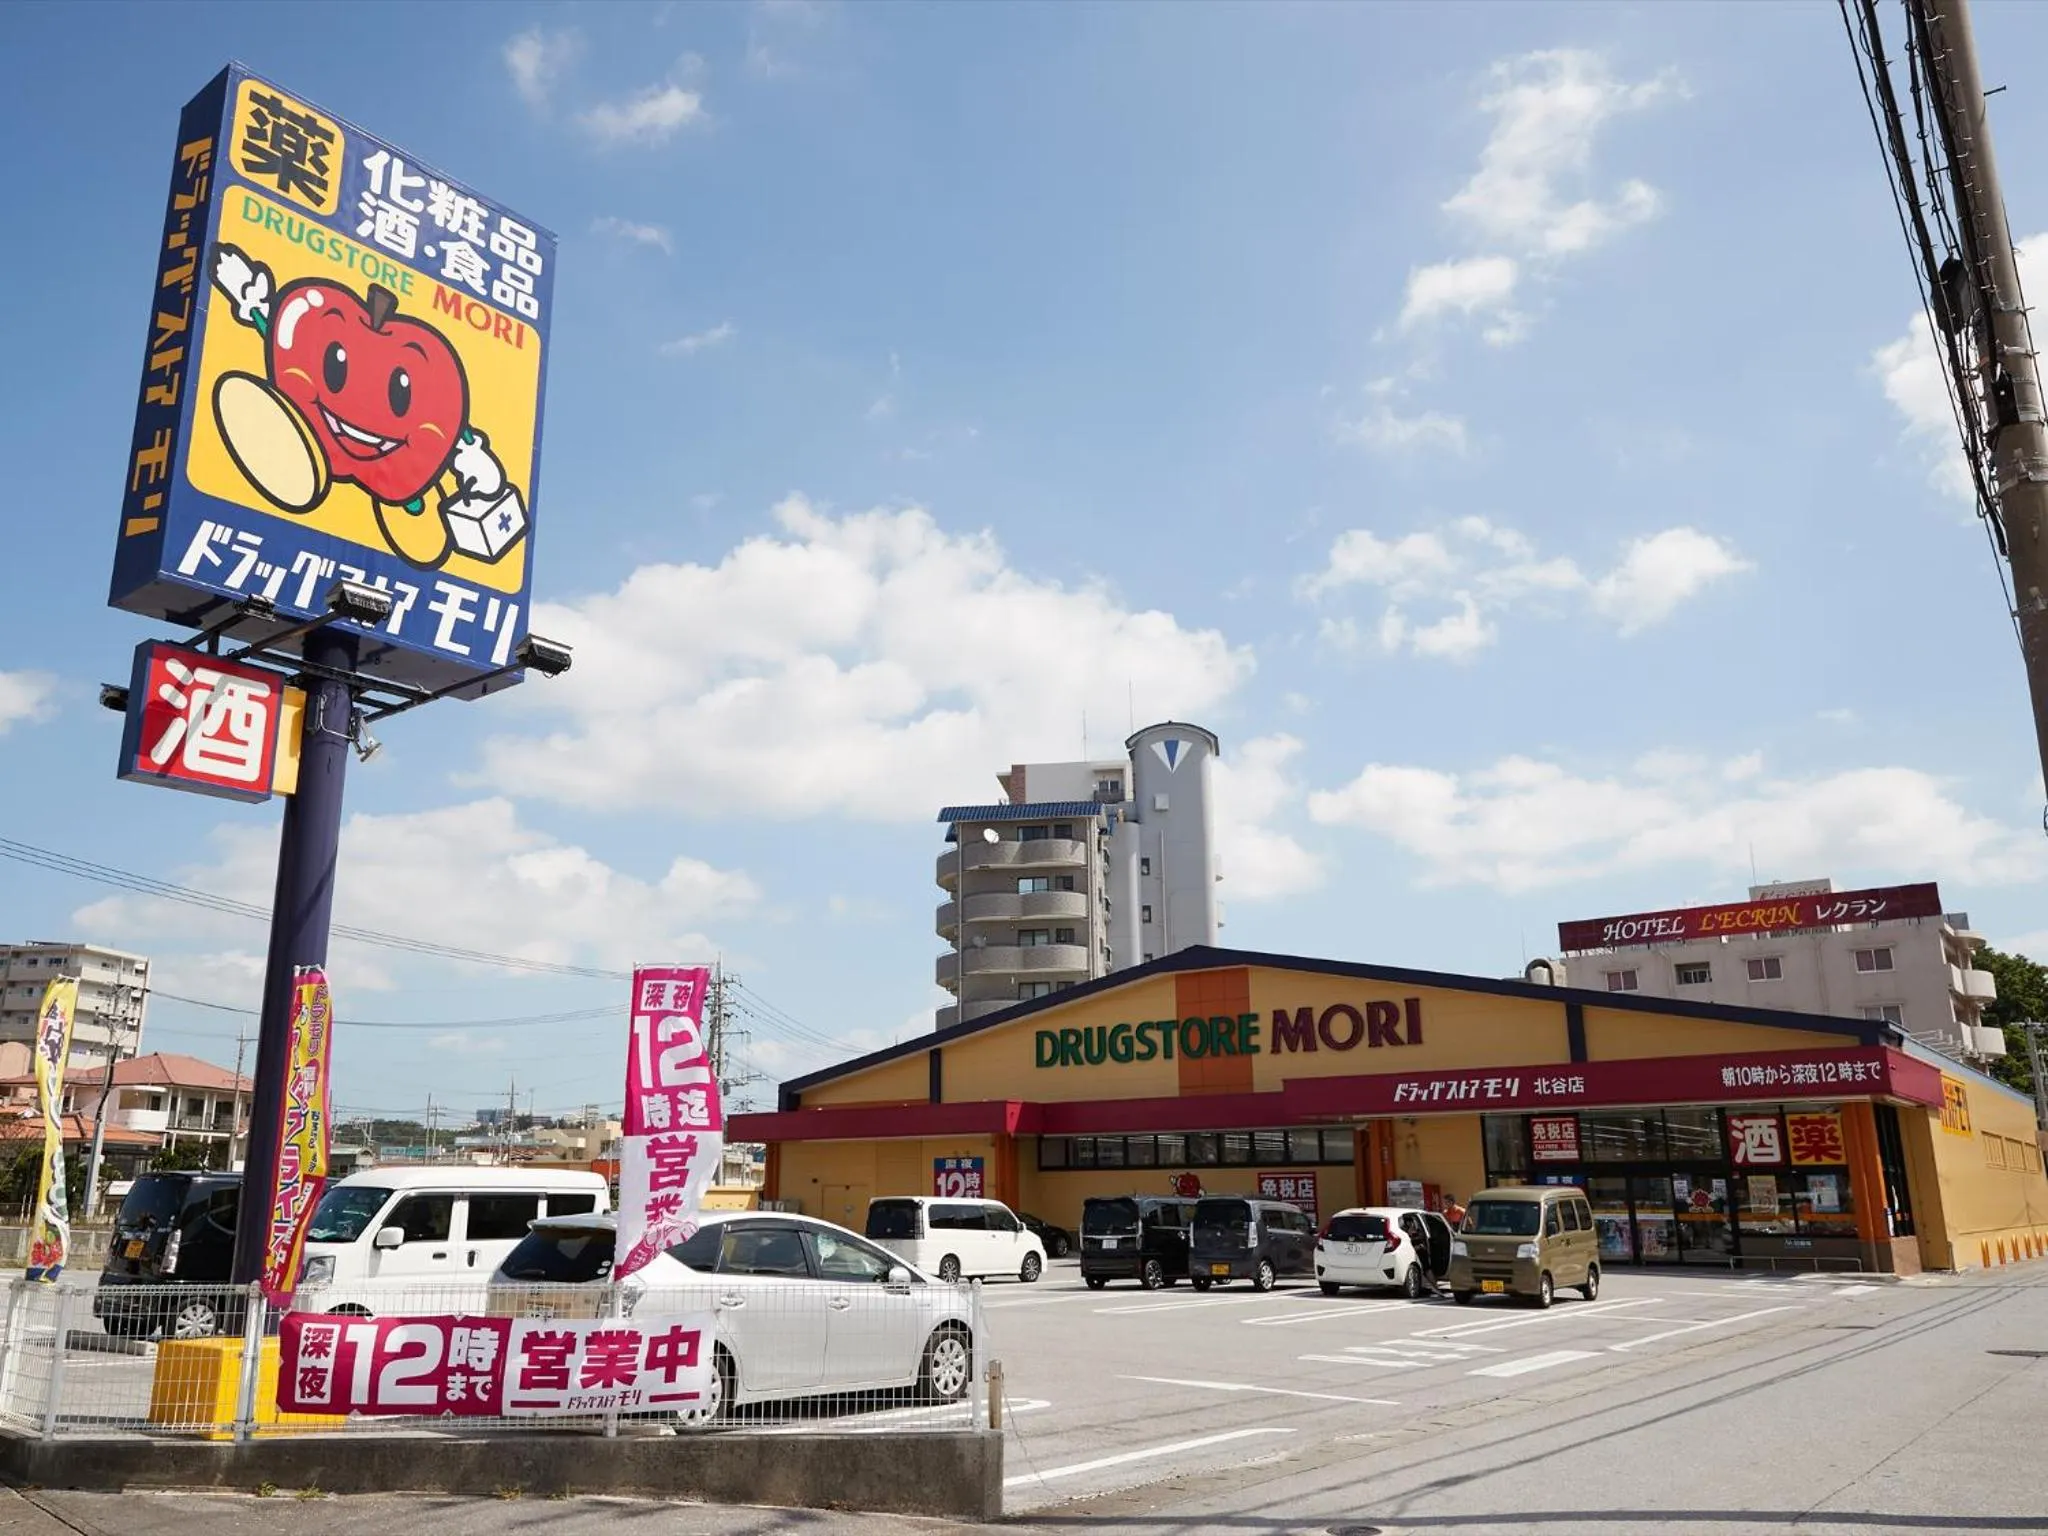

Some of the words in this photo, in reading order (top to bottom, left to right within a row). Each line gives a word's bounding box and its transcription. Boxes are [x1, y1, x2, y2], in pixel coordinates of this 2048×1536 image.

[242, 88, 335, 208] 薬
[363, 149, 543, 276] 化粧品
[242, 195, 414, 297] DRUGSTORE
[432, 280, 524, 350] MORI
[356, 191, 539, 320] 酒・食品
[150, 657, 270, 783] 酒
[1603, 916, 1686, 942] HOTEL
[1699, 902, 1803, 931] L'ECRIN
[1815, 899, 1887, 919] レクラン
[633, 1015, 711, 1088] 12
[1035, 1013, 1260, 1068] DRUGSTORE
[1271, 997, 1423, 1055] MORI
[1534, 1076, 1585, 1096] 北谷店
[1721, 1060, 1881, 1087] 朝10時から深夜12時まで
[1533, 1122, 1575, 1140] 免税店
[1731, 1118, 1782, 1164] 酒
[1791, 1116, 1844, 1163] 薬
[1261, 1178, 1315, 1198] 免税店
[299, 1326, 333, 1400] 深夜
[344, 1323, 444, 1405] 12
[446, 1374, 494, 1402] まで
[519, 1324, 701, 1391] 営業中
